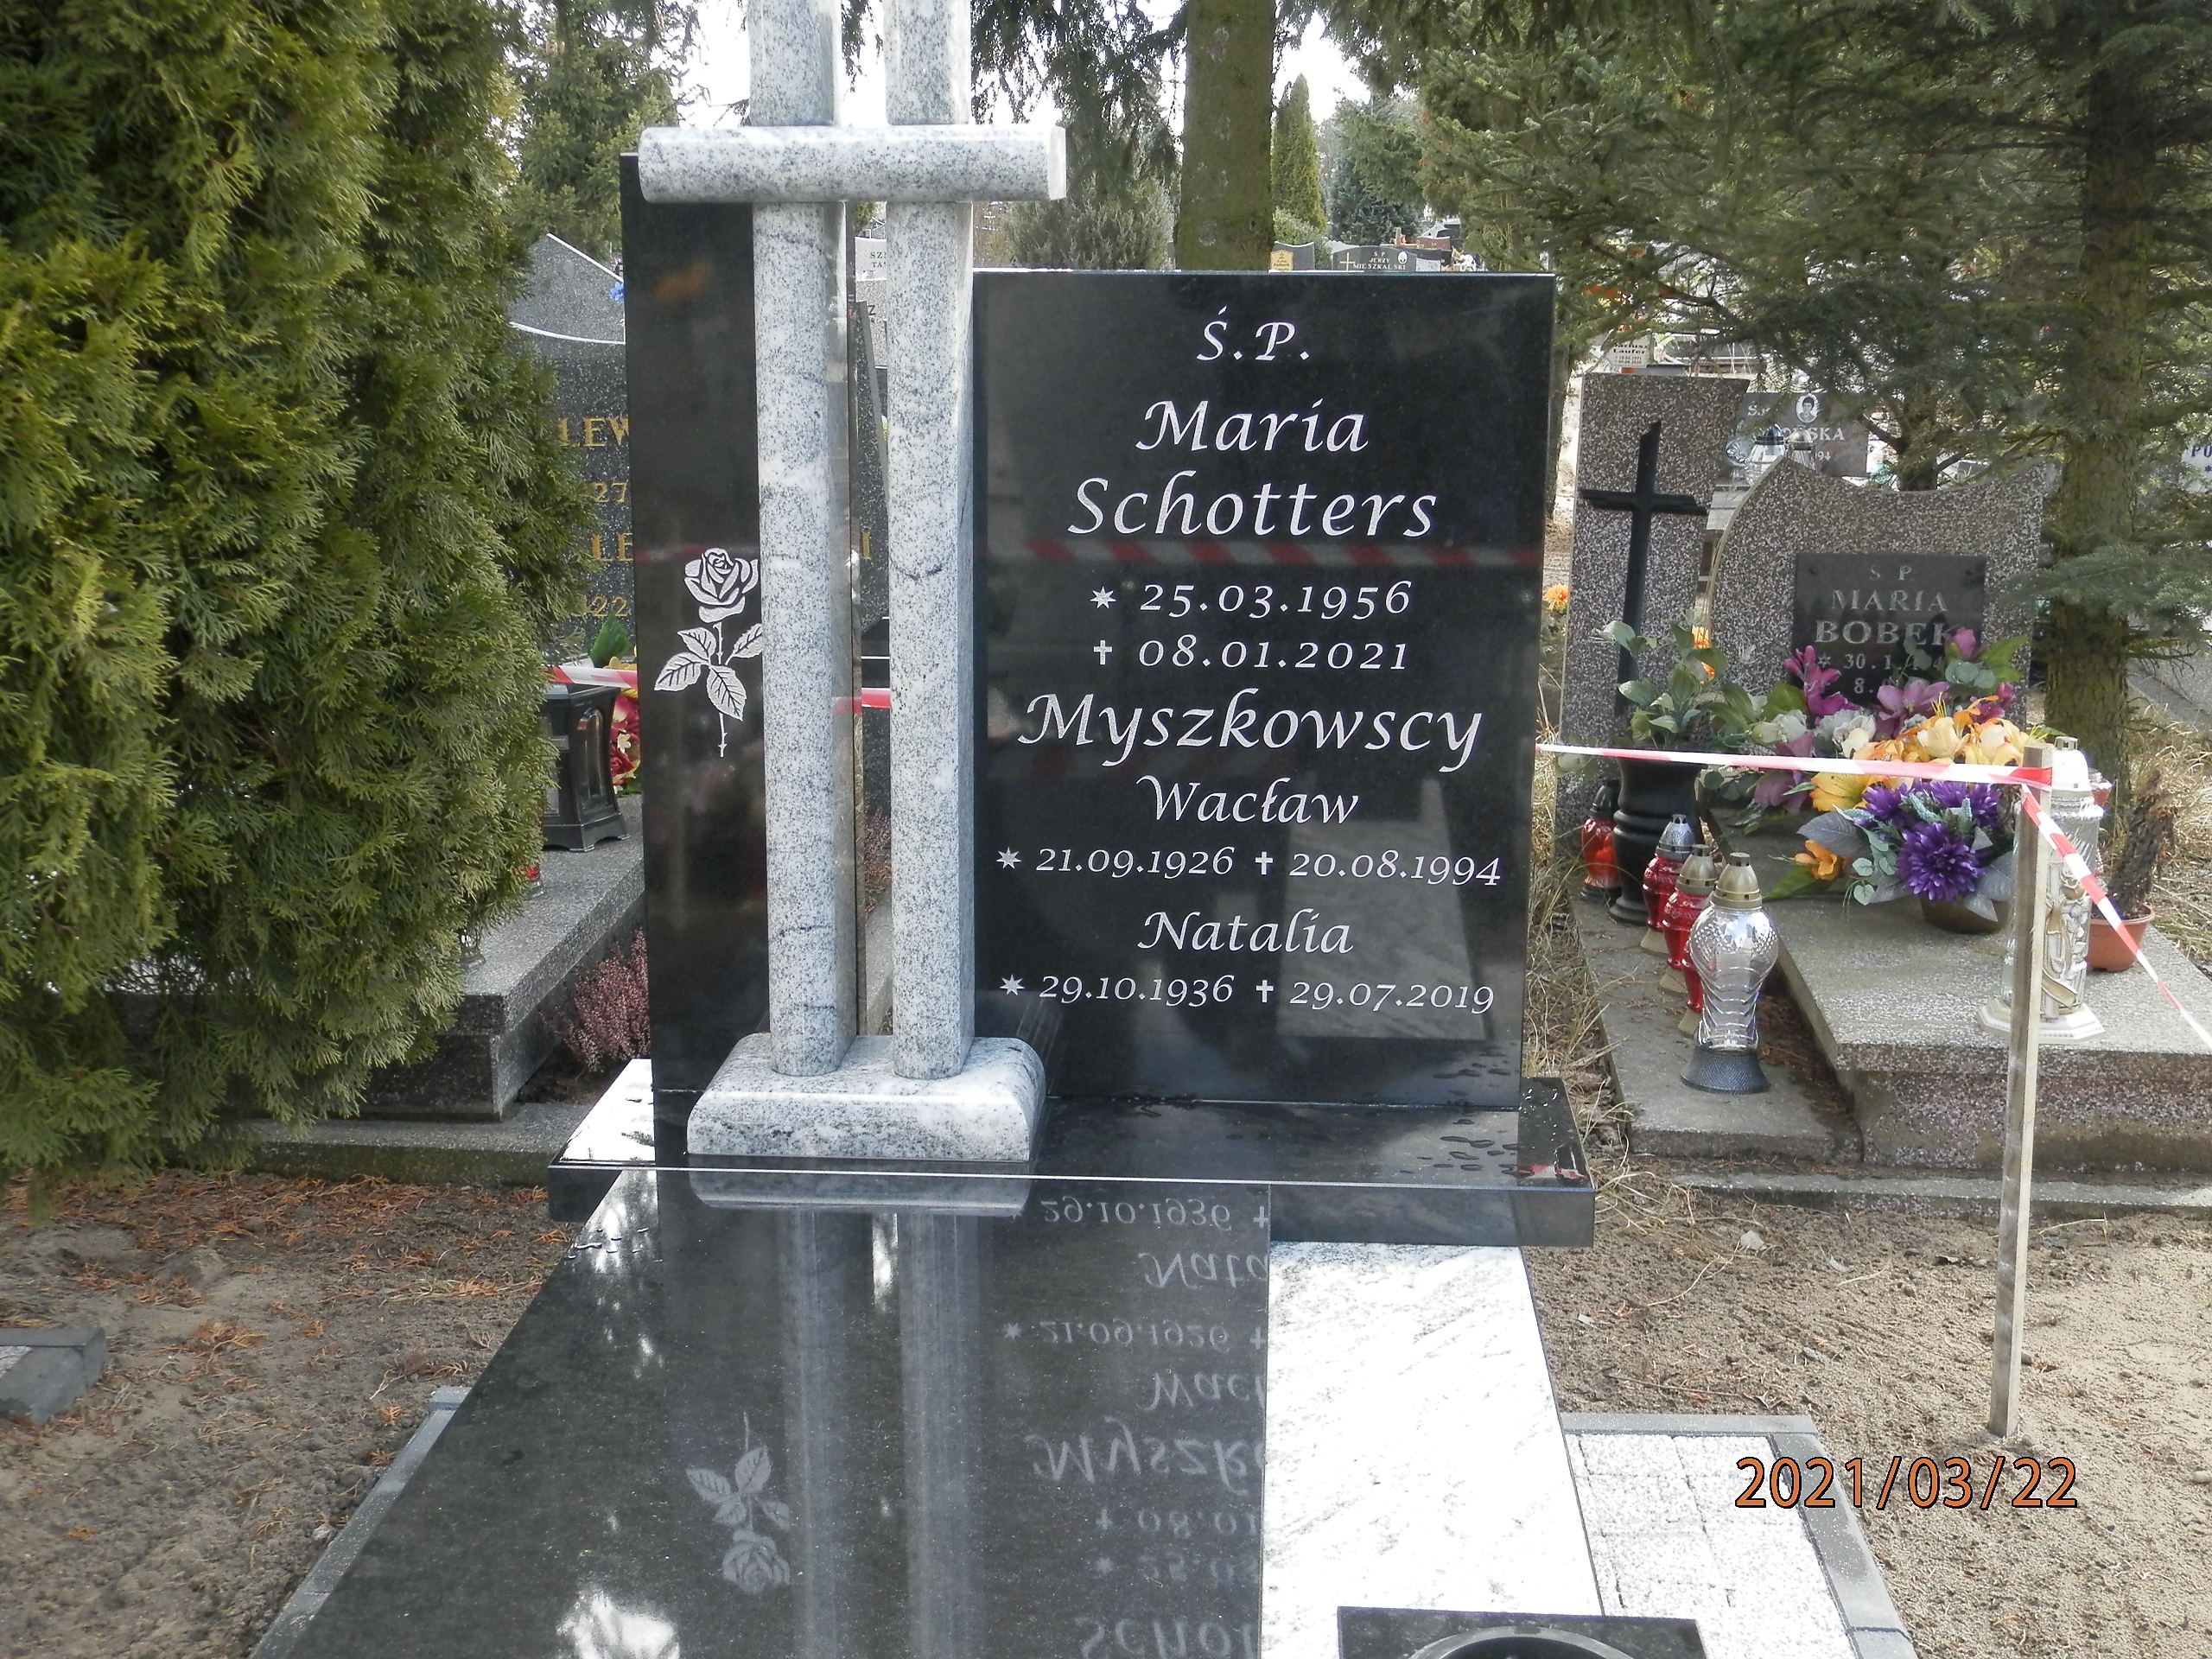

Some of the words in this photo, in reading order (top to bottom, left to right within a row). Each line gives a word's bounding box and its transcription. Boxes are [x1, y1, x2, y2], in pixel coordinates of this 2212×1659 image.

[1196, 305, 1310, 361] Ś.P.
[555, 416, 629, 447] LEW
[1135, 397, 1369, 452] Maria
[2191, 443, 2212, 458] PU
[1067, 469, 1437, 537] Schotters
[591, 531, 634, 562] LE
[1140, 580, 1412, 620] 25.03.1956
[1832, 589, 1948, 612] MARIA
[1139, 633, 1407, 670] 08.01.2021
[1017, 688, 1483, 772] Myszkowscy
[1135, 775, 1359, 824] Wacław
[1035, 846, 1236, 880] 21.09.1926
[1288, 849, 1501, 886] 20.08.1994
[1136, 907, 1354, 954] Natalia
[1039, 974, 1235, 1007] 29.10.1936
[1289, 982, 1494, 1014] 29.07.2019
